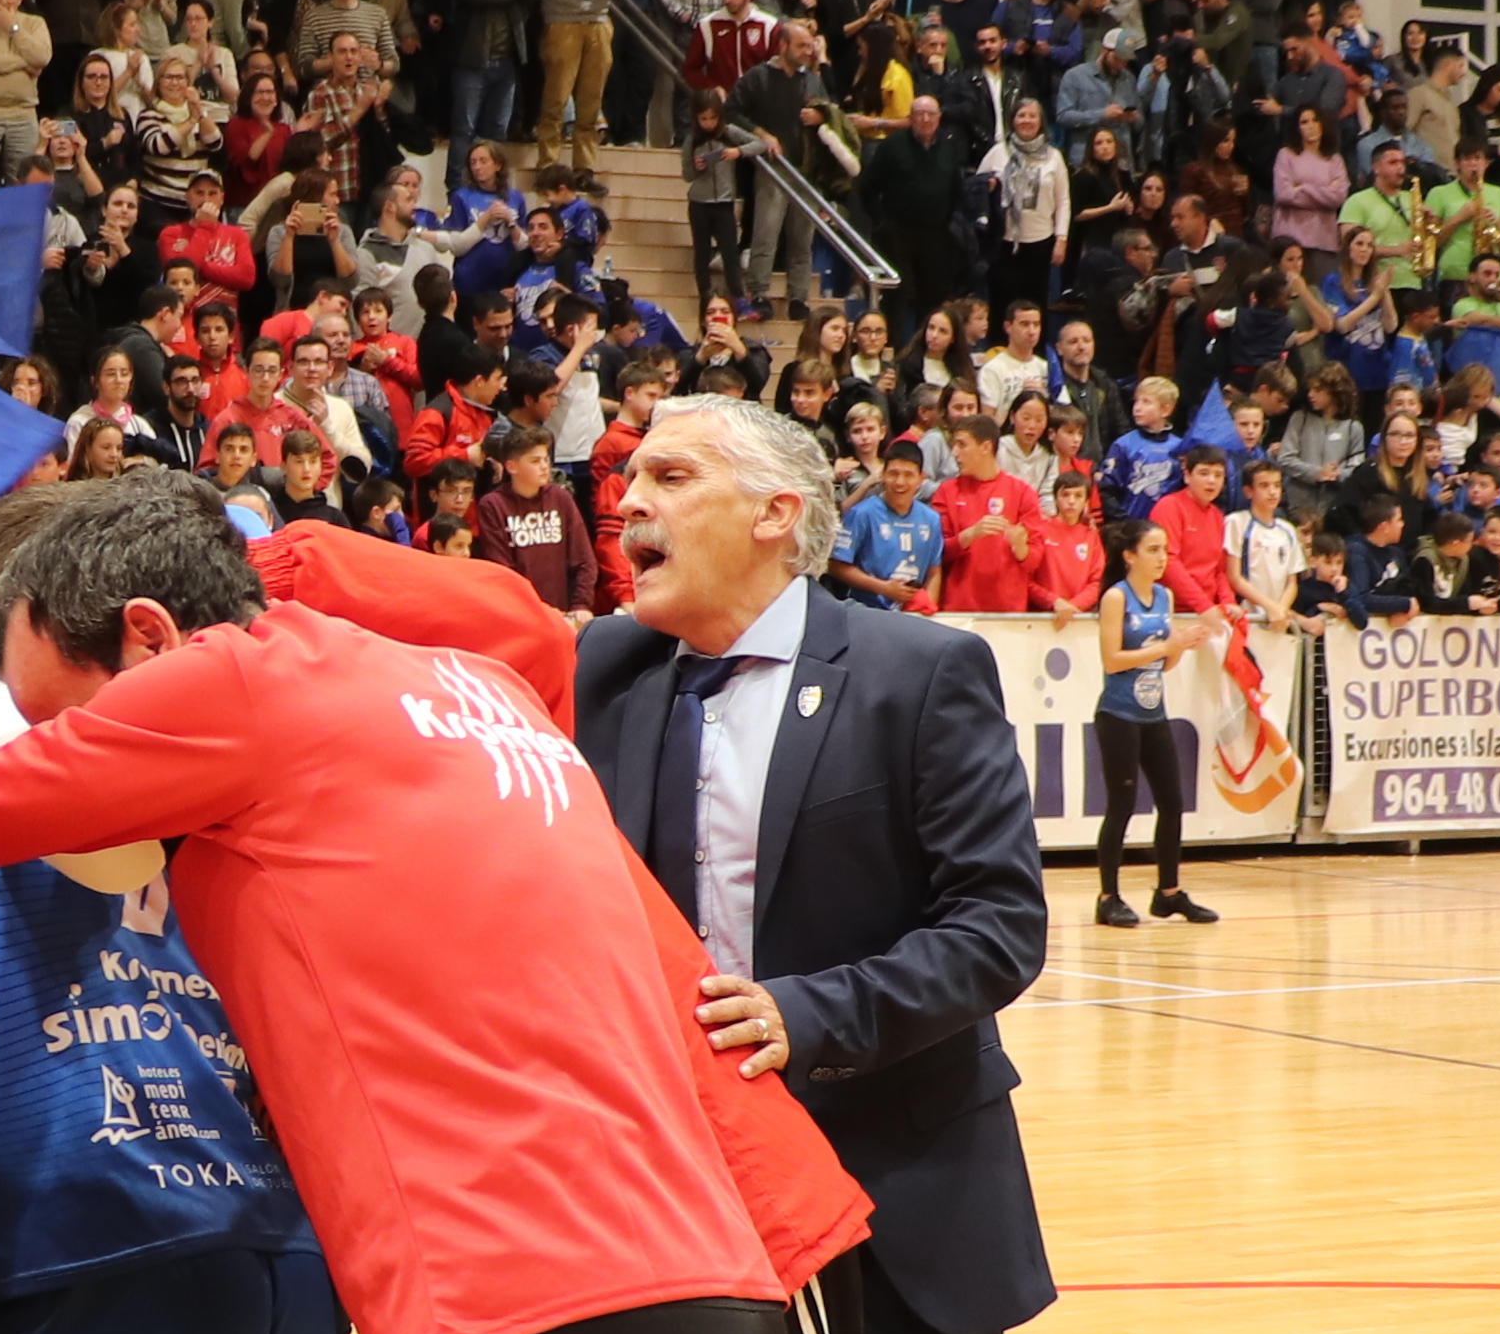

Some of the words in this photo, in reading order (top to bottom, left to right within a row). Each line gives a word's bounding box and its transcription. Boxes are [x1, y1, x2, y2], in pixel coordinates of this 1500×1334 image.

[1344, 730, 1457, 762] Excursiones
[1382, 771, 1449, 816] 964
[1455, 771, 1487, 814] 48
[42, 982, 172, 1053] simó
[148, 1161, 246, 1189] TOKA
